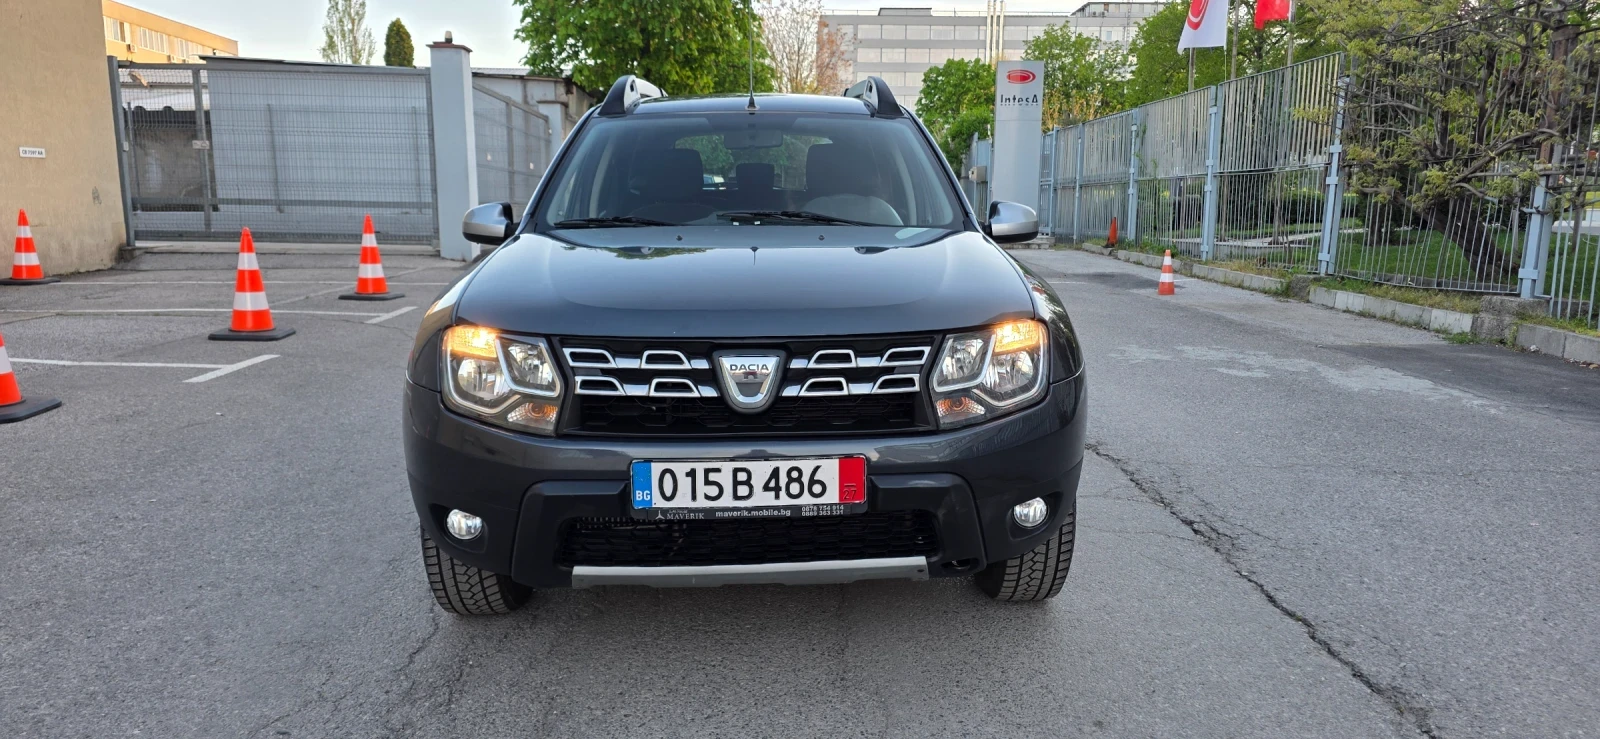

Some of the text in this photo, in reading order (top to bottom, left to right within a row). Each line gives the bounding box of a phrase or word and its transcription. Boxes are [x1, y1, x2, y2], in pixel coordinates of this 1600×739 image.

[635, 490, 651, 501] BG
[843, 489, 856, 500] 27
[715, 508, 791, 517] maverik.mobile.bg
